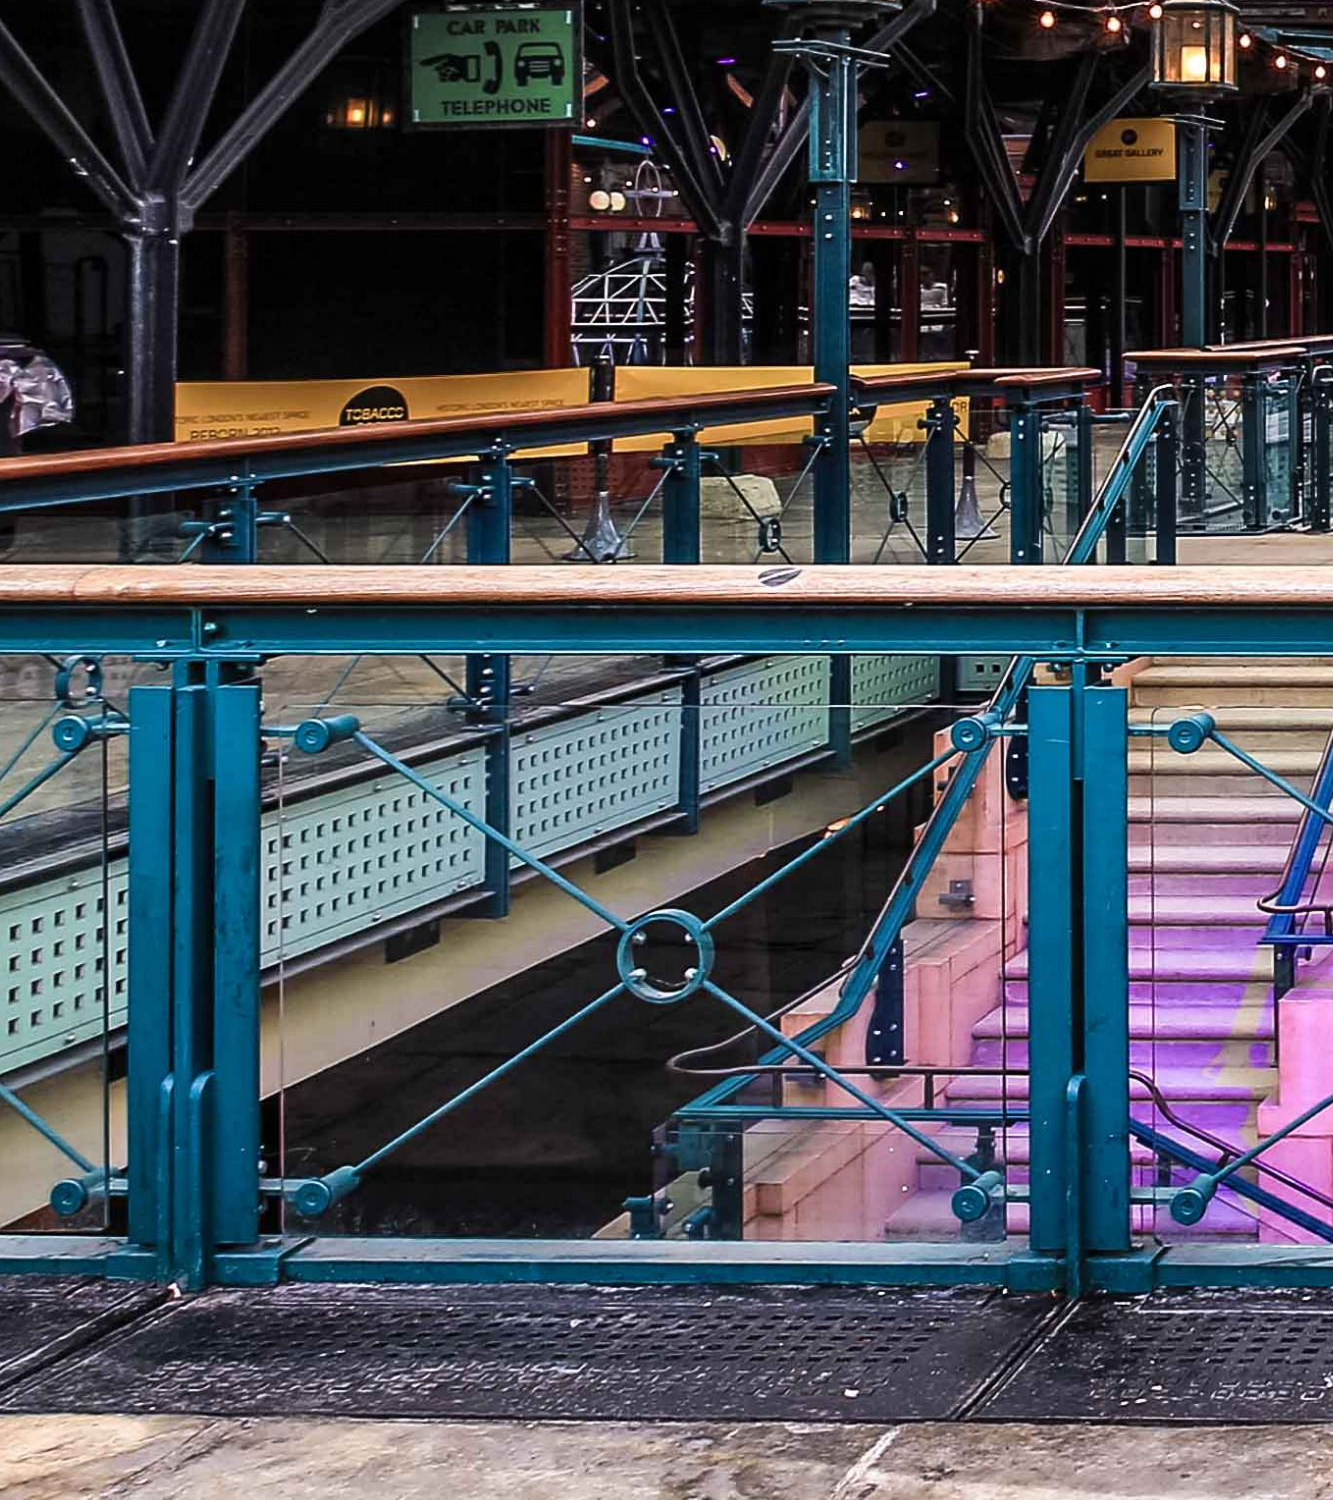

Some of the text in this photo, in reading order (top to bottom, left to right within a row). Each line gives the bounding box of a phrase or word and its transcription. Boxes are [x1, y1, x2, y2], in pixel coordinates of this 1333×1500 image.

[447, 18, 541, 36] CAR PARK
[441, 98, 551, 116] TELEPHONE
[1095, 148, 1164, 158] GREAT GALLERY
[345, 406, 405, 420] TOBACCO
